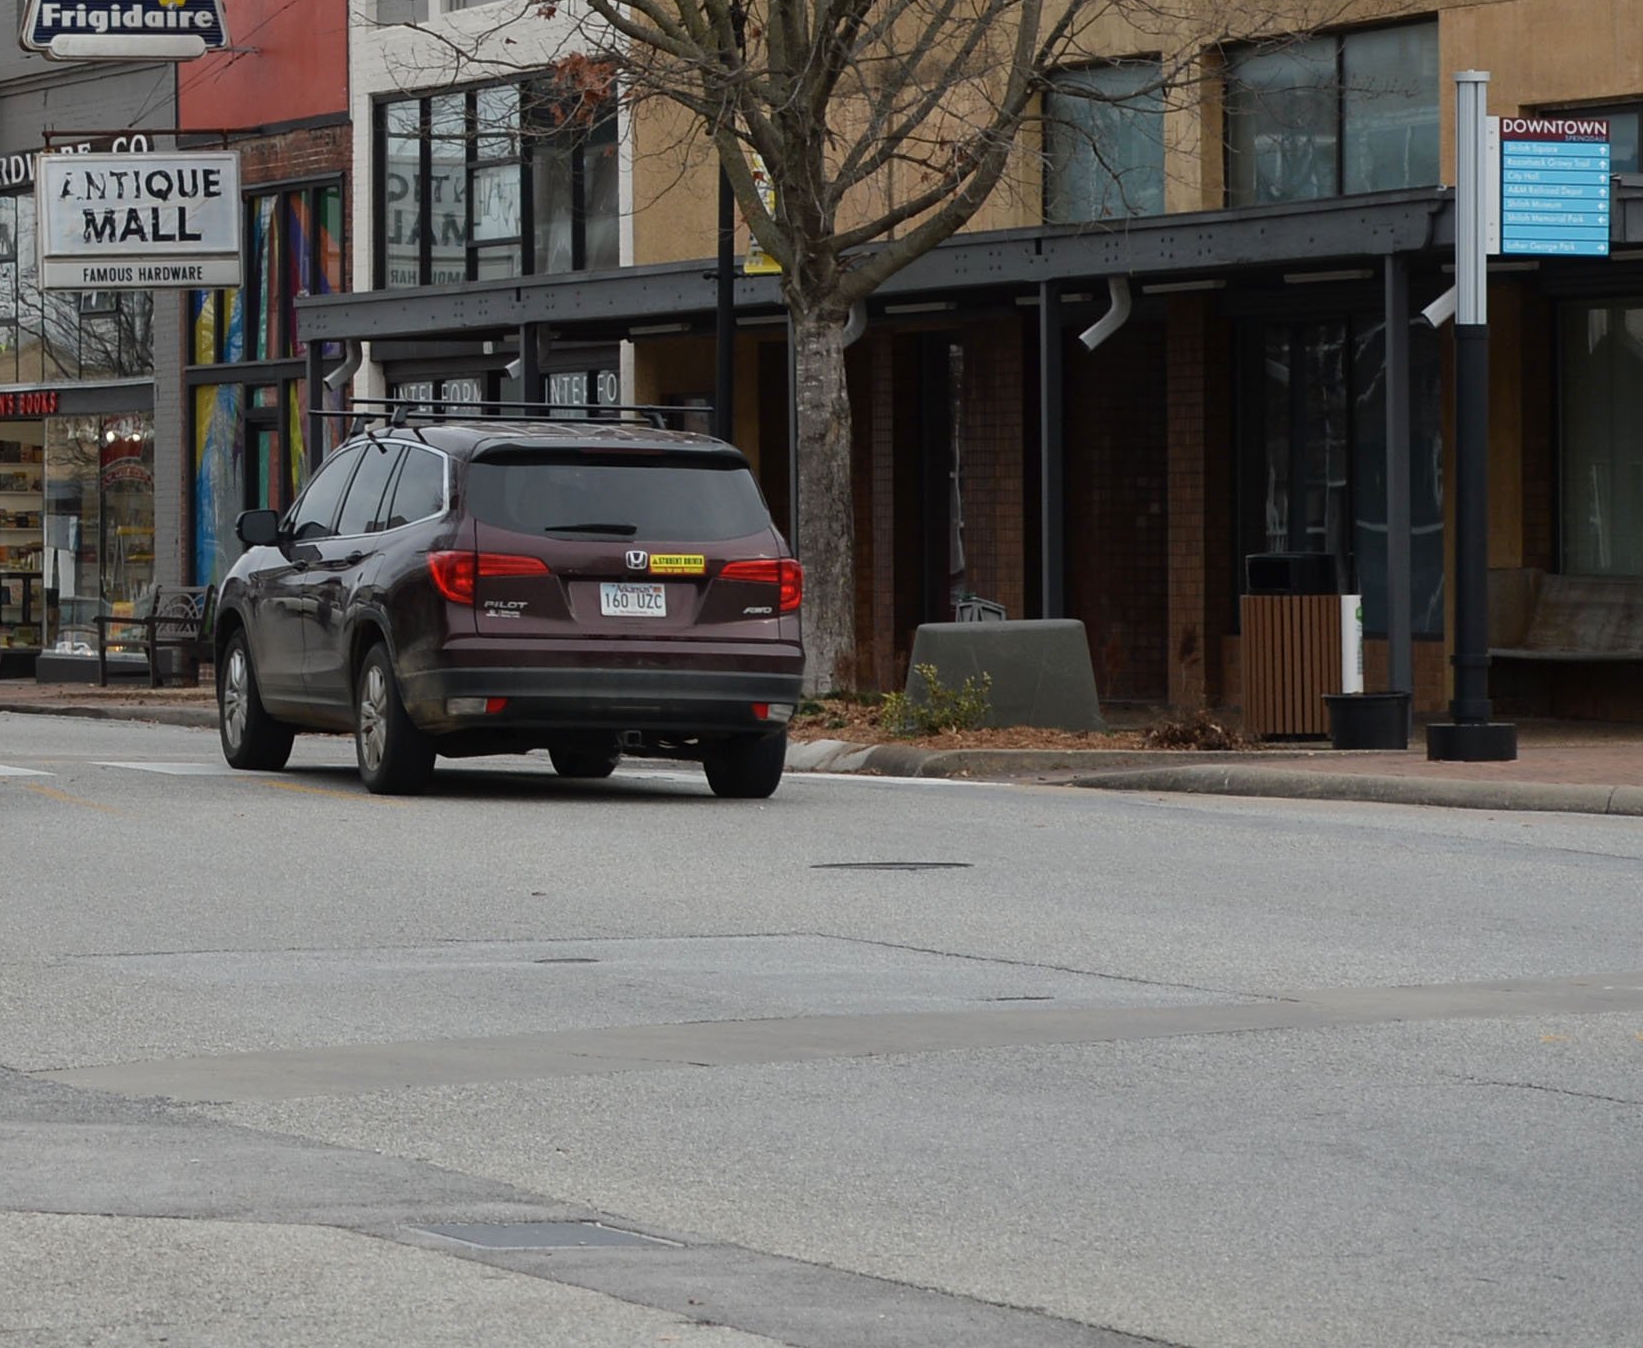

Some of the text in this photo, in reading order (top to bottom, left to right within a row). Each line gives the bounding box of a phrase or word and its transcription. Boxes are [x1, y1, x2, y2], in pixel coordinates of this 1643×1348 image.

[41, 2, 214, 33] Frigidaire
[1502, 119, 1607, 135] DOWNTOWN
[59, 169, 222, 201] ANTIQUE
[82, 206, 203, 244] MALL
[83, 266, 203, 283] FAMOUS HARDWARE
[19, 391, 58, 414] BOOKS
[484, 600, 528, 609] PILOT
[606, 593, 663, 609] 160 UZC
